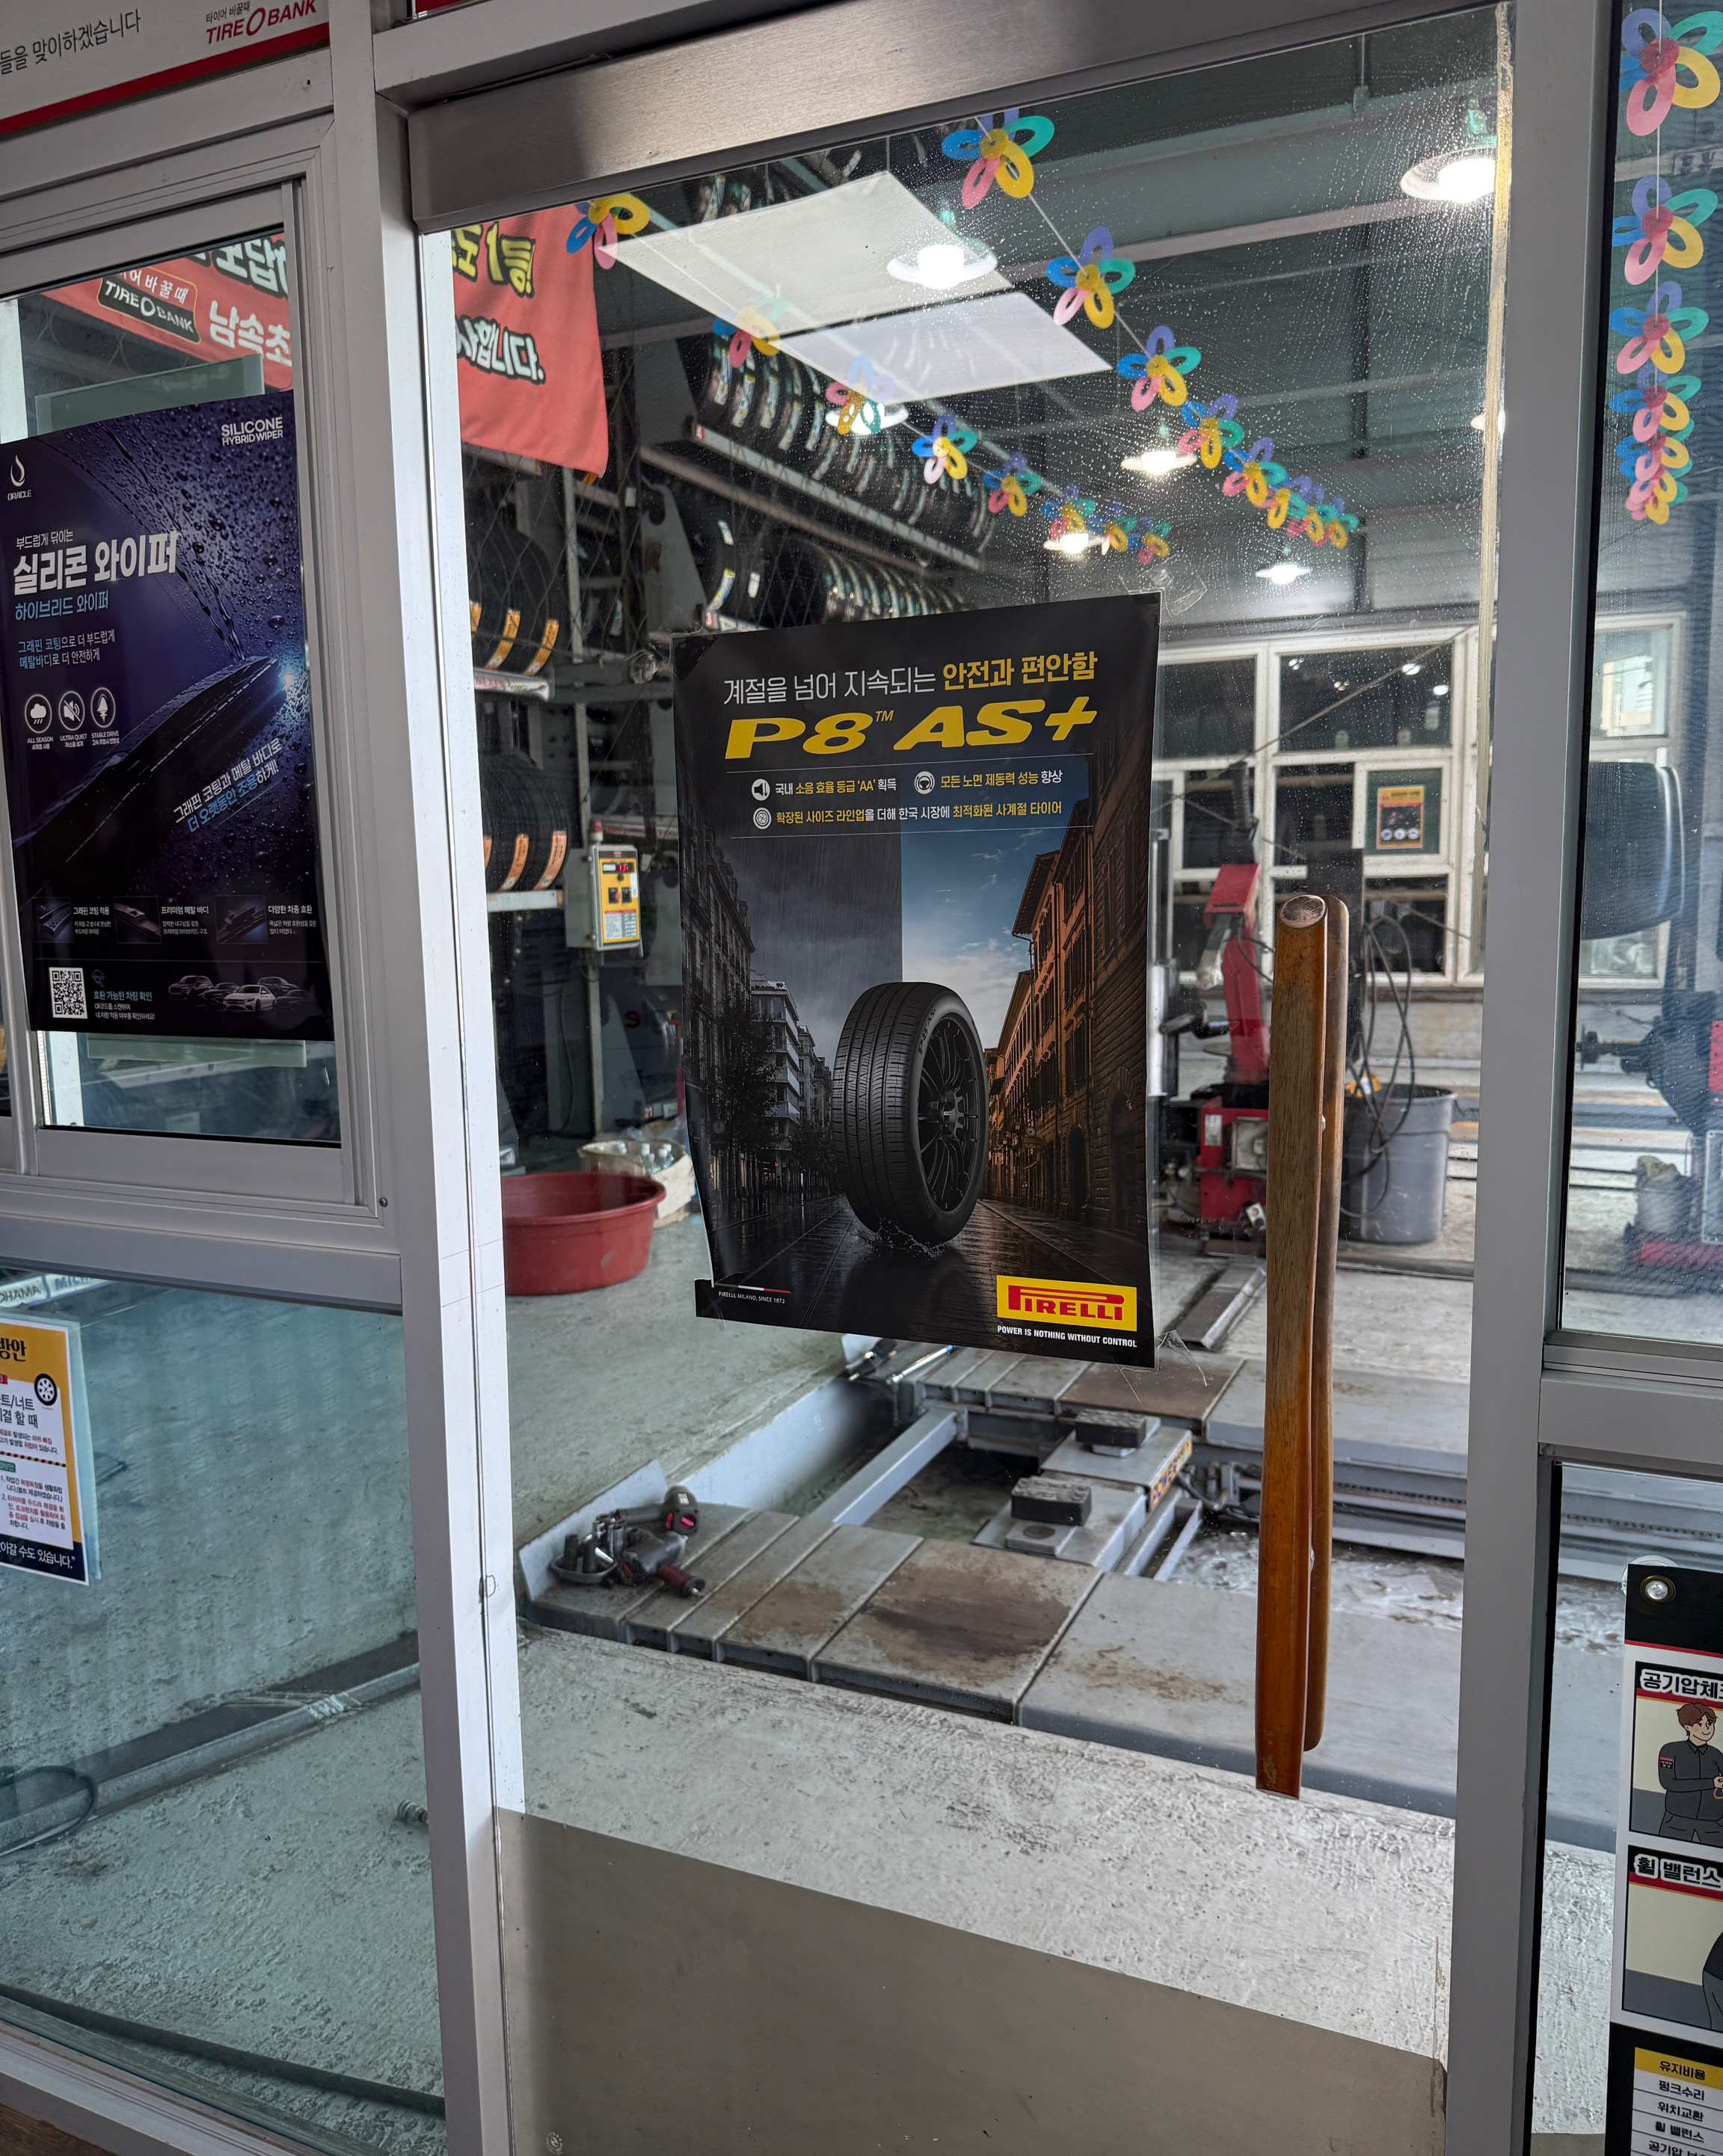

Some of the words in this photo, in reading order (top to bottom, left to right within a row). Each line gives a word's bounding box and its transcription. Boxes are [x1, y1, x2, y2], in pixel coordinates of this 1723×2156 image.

[206, 8, 227, 23] 타이어
[32, 9, 141, 64] 맞이하겠습니다
[221, 417, 283, 437] SILICONE
[221, 433, 256, 446] HYBRID
[256, 429, 283, 442] WIPER
[16, 532, 49, 550] 부드럽게
[51, 529, 74, 545] 닦이는
[13, 544, 88, 596] 실리콘
[94, 530, 179, 583] 와이퍼
[15, 597, 73, 621] 하이브리드
[76, 590, 109, 613] 와이퍼
[18, 638, 43, 653] 그래핀
[45, 635, 76, 651] 코팅으로
[78, 633, 85, 647] 더
[87, 629, 116, 644] 부드럽게
[19, 654, 60, 669] 메탈바디로
[62, 651, 70, 665] 더
[71, 648, 100, 664] 안전하게
[724, 676, 787, 704] 계절을
[794, 673, 836, 701] 넘어
[844, 666, 936, 697] 지속되는
[943, 658, 1015, 691] 안전과
[1021, 651, 1099, 684] 편안함
[894, 696, 1098, 751] AS+
[173, 793, 203, 823] 그래핀
[202, 772, 232, 802] 코팅과
[230, 758, 253, 781] 메탈
[251, 737, 283, 767] 바디로
[775, 782, 793, 795] 국내
[795, 781, 814, 794] 소음
[815, 781, 835, 793] 효율
[836, 780, 856, 793] 등급
[877, 778, 897, 791] 획득
[940, 776, 961, 788] 모든
[962, 774, 983, 787] 노면
[985, 773, 1015, 786] 제동력
[1017, 771, 1039, 784] 성능
[1040, 770, 1063, 784] 향상
[187, 814, 200, 833] 더
[199, 787, 238, 825] 오랫동안
[236, 759, 279, 798] 조용하게!
[775, 811, 803, 824] 확장된
[805, 810, 834, 823] 사이즈
[836, 808, 875, 822] 라인업을
[876, 808, 896, 821] 더해
[898, 807, 918, 820] 한국
[921, 805, 950, 819] 시장에
[953, 804, 993, 817] 최적화된
[995, 802, 1027, 816] 사계절
[1030, 801, 1062, 814] 타이어
[197, 906, 209, 915] 바디
[106, 991, 125, 1001] 가능한
[126, 991, 138, 1001] 차량
[1007, 1285, 1125, 1321] PIRELLI
[997, 1325, 1022, 1335] POWER
[1025, 1328, 1032, 1336] IS
[1034, 1330, 1066, 1340] NOTHING
[1067, 1333, 1101, 1344] WITHOUT
[1102, 1336, 1137, 1348] CONTROL
[0, 1394, 35, 1412] 트/너트
[15, 1410, 25, 1426] 할
[28, 1413, 38, 1428] 때
[38, 1444, 59, 1454] 있습니다.
[0, 1541, 17, 1557] 아갈
[19, 1546, 36, 1559] 수도
[1637, 1856, 1655, 1876] 휠
[1663, 1861, 1721, 1888] 밸런스
[1659, 2060, 1706, 2080] 유지비용
[1659, 2080, 1705, 2101] 펑크수리
[1657, 2101, 1704, 2122] 위치교환
[1670, 2124, 1704, 2143] 밸런스
